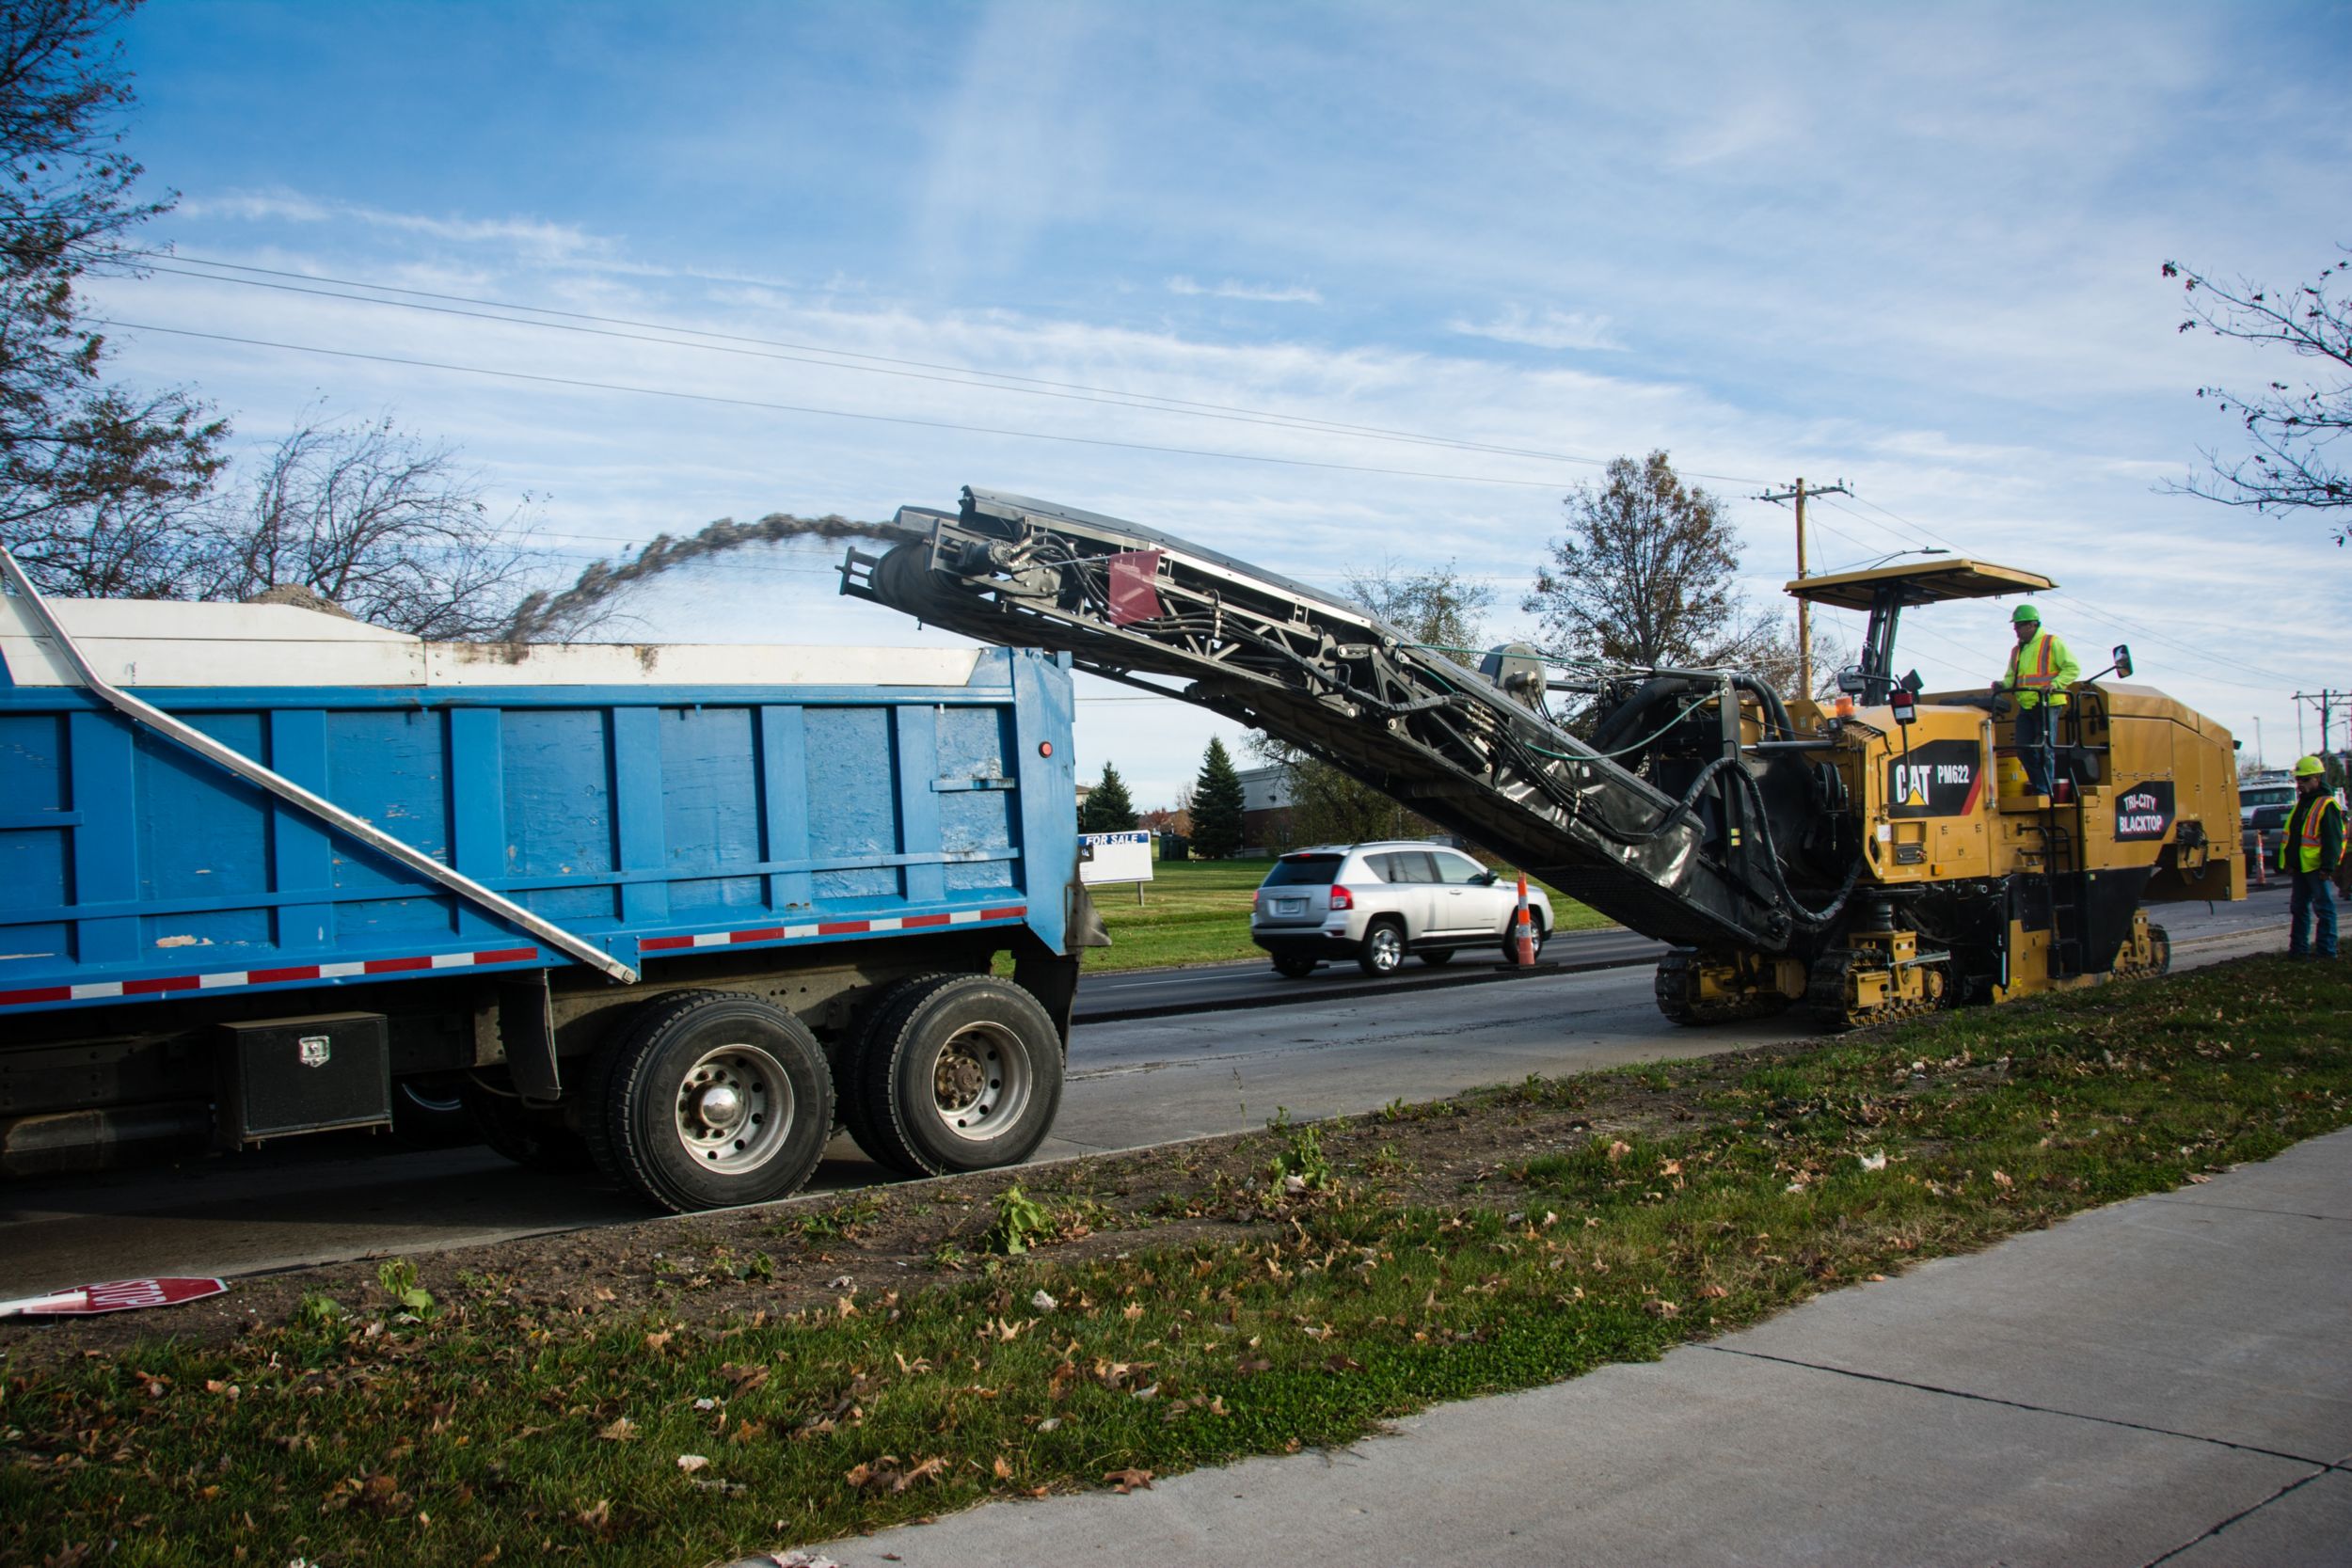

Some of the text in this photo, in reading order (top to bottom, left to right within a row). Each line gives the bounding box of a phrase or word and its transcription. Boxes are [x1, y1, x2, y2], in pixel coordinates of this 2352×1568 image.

[1896, 764, 1969, 805] CAT PM622
[2123, 794, 2156, 811] TRI-CITY
[2120, 816, 2162, 832] BLACKTOP
[1086, 834, 1137, 846] FOR SALE
[89, 1280, 167, 1306] STOP
